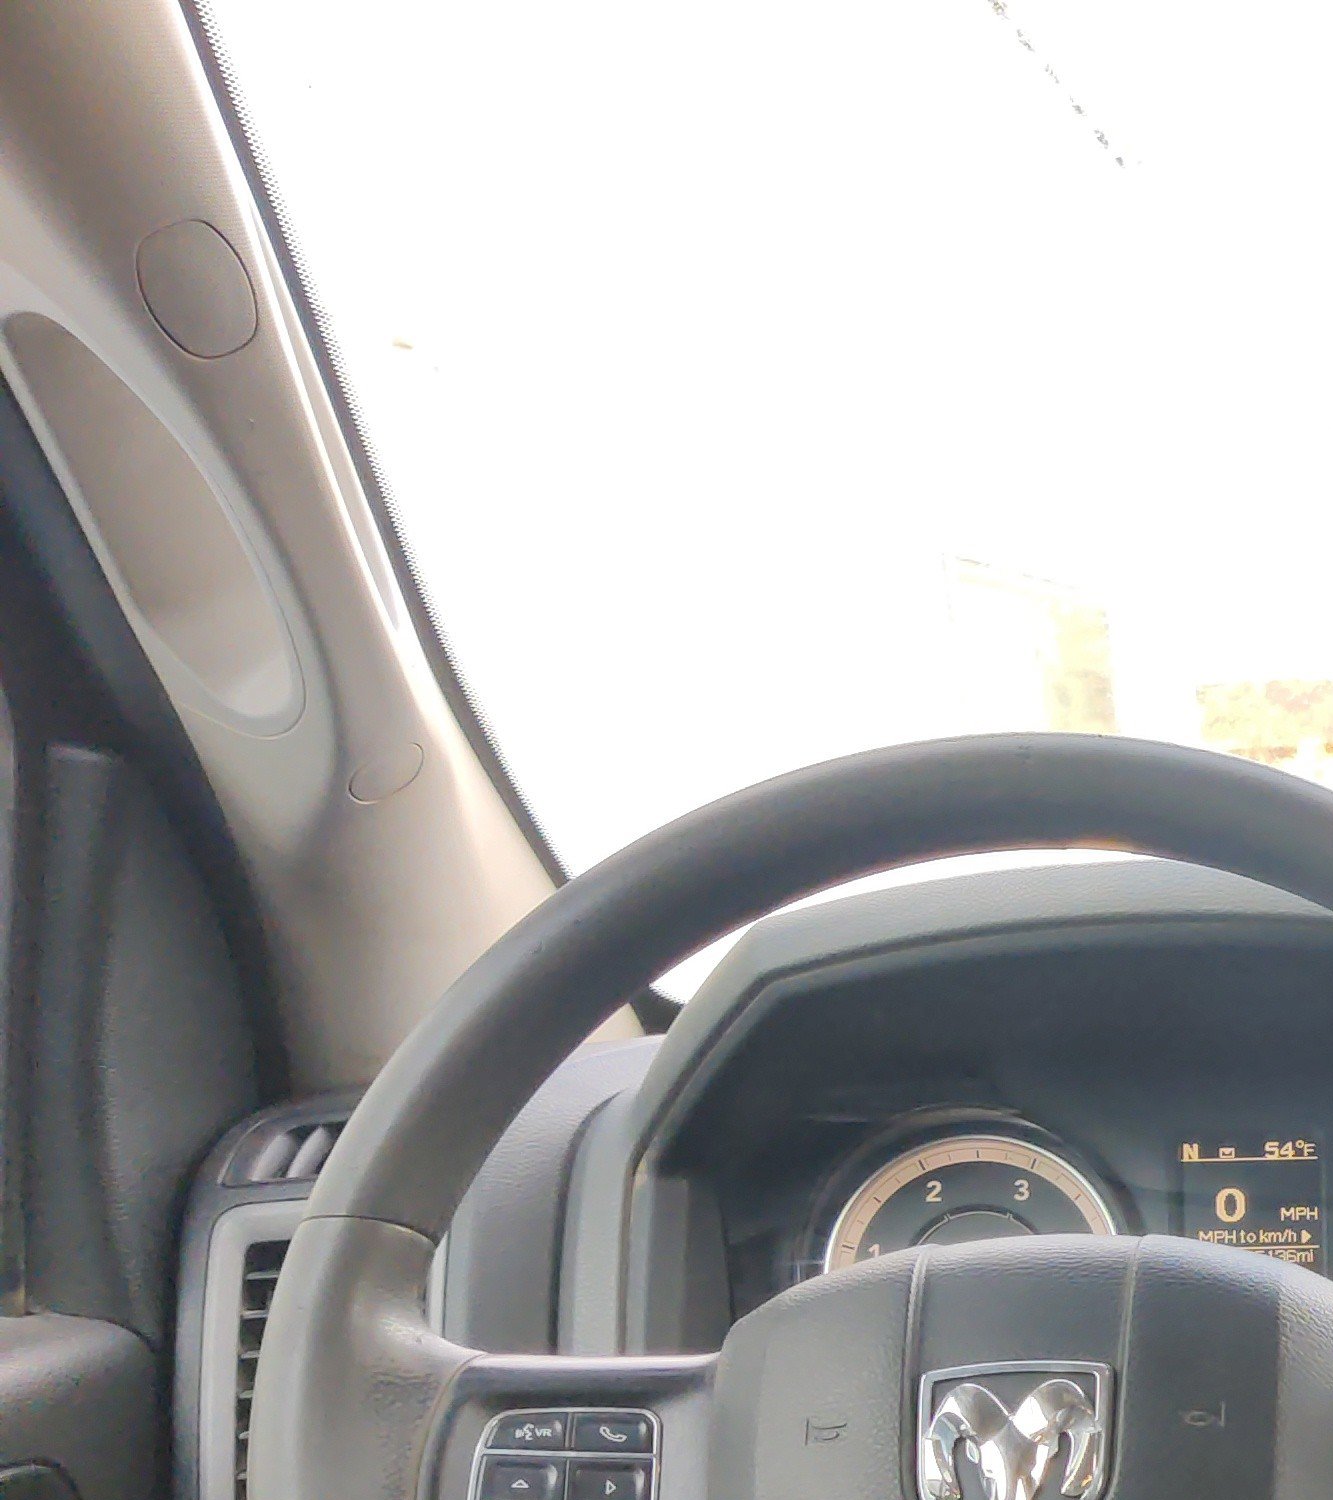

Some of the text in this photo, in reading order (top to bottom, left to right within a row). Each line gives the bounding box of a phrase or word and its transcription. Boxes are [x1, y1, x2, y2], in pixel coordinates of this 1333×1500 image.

[1182, 1143, 1199, 1160] N
[925, 1180, 942, 1202] 2
[1014, 1179, 1030, 1201] 3
[1216, 1187, 1318, 1222] 0 MPH
[1198, 1228, 1297, 1244] MPH to km/h
[534, 1427, 552, 1437] VR
